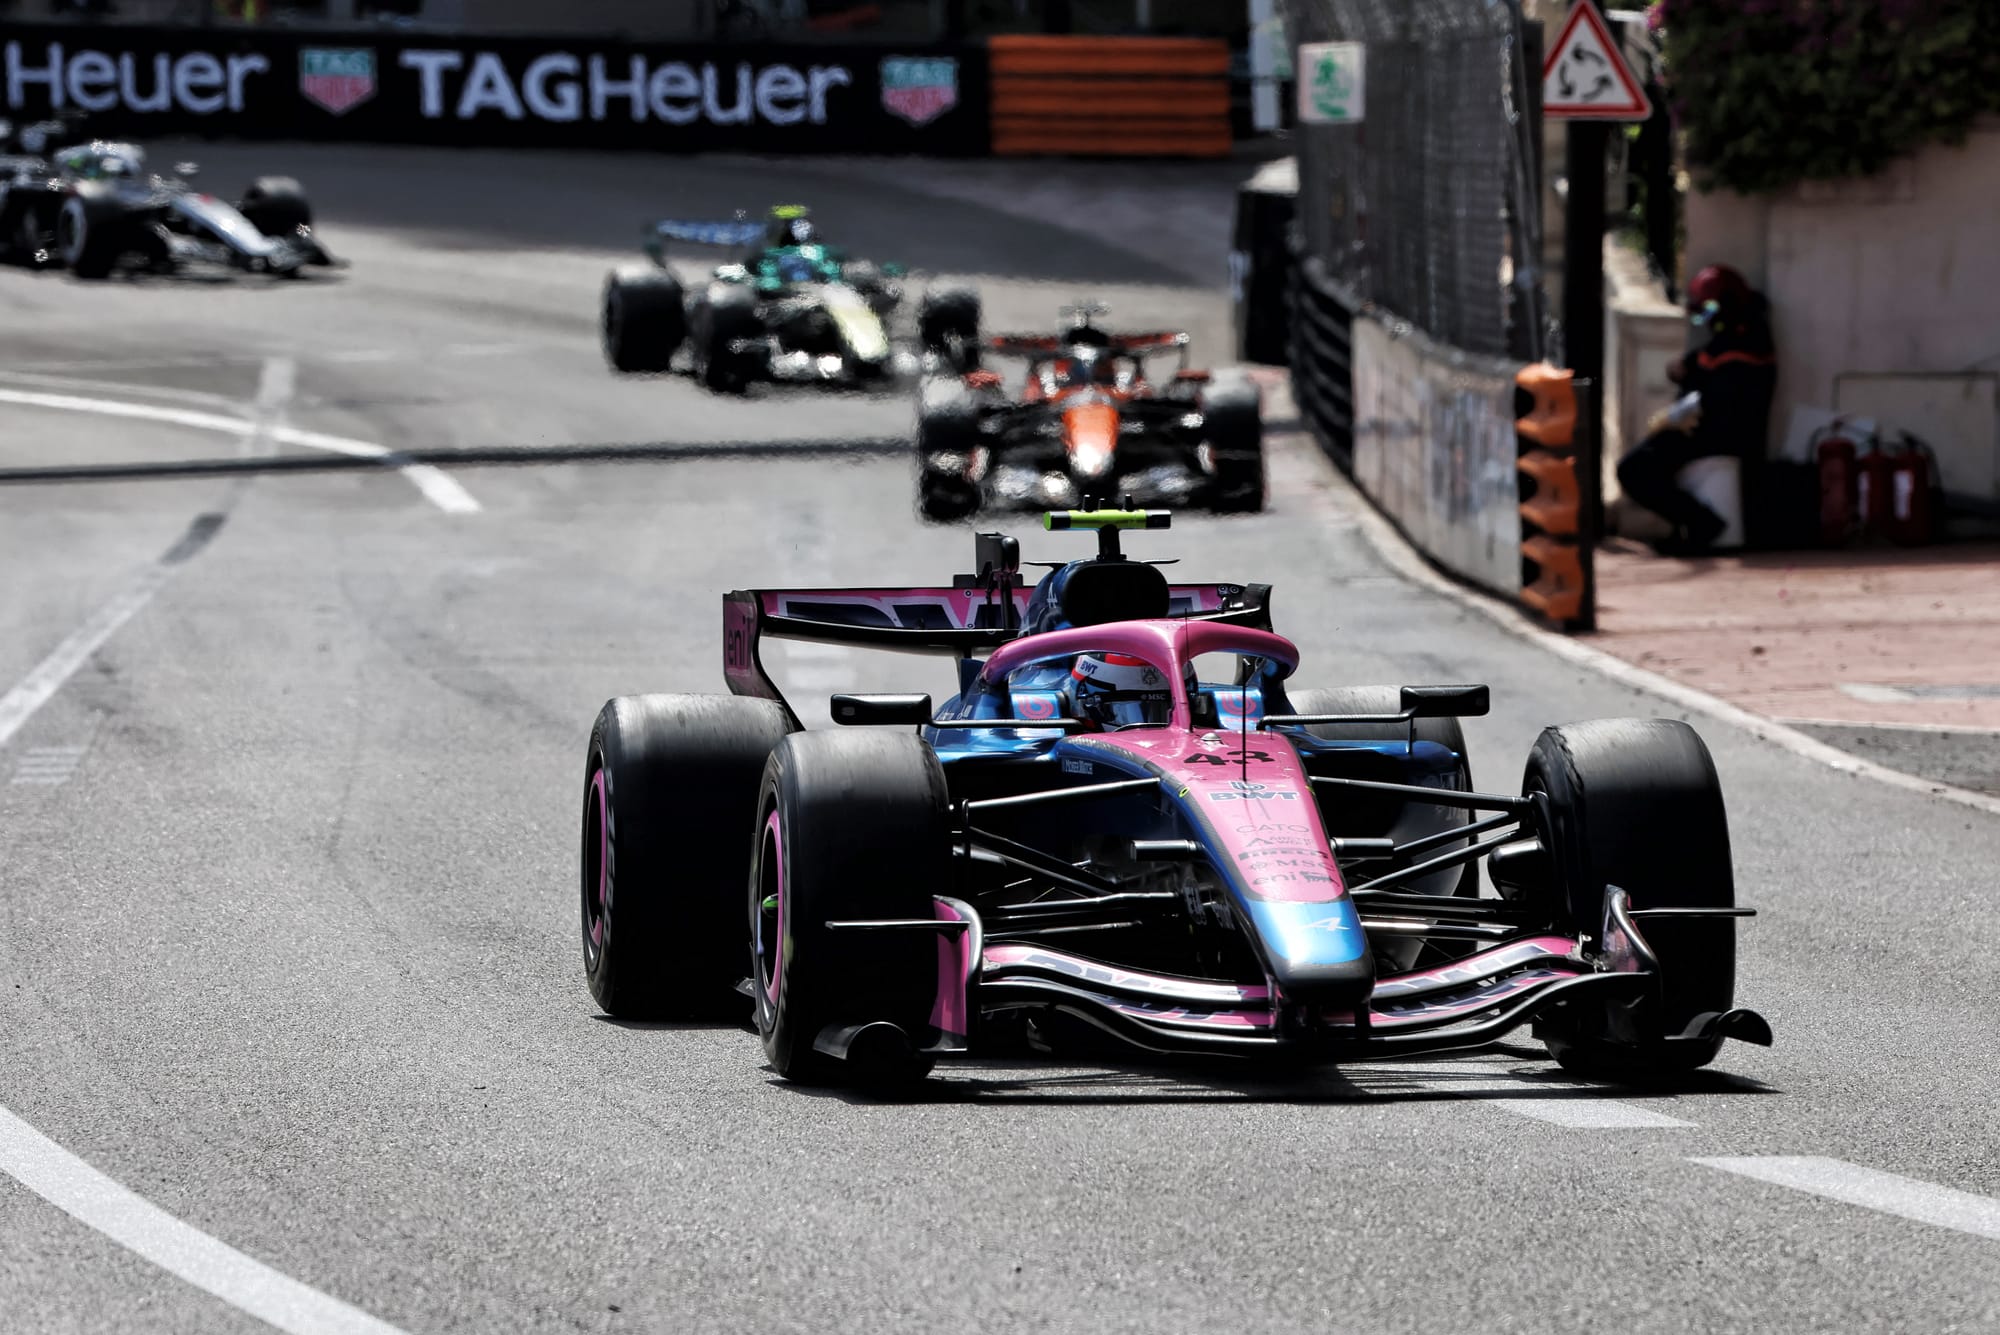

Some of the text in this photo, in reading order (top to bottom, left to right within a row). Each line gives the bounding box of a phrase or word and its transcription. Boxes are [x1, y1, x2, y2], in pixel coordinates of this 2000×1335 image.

[5, 40, 270, 113] Heuer
[1184, 751, 1275, 766] 43
[1209, 791, 1299, 801] BWT
[1236, 823, 1309, 833] CATO
